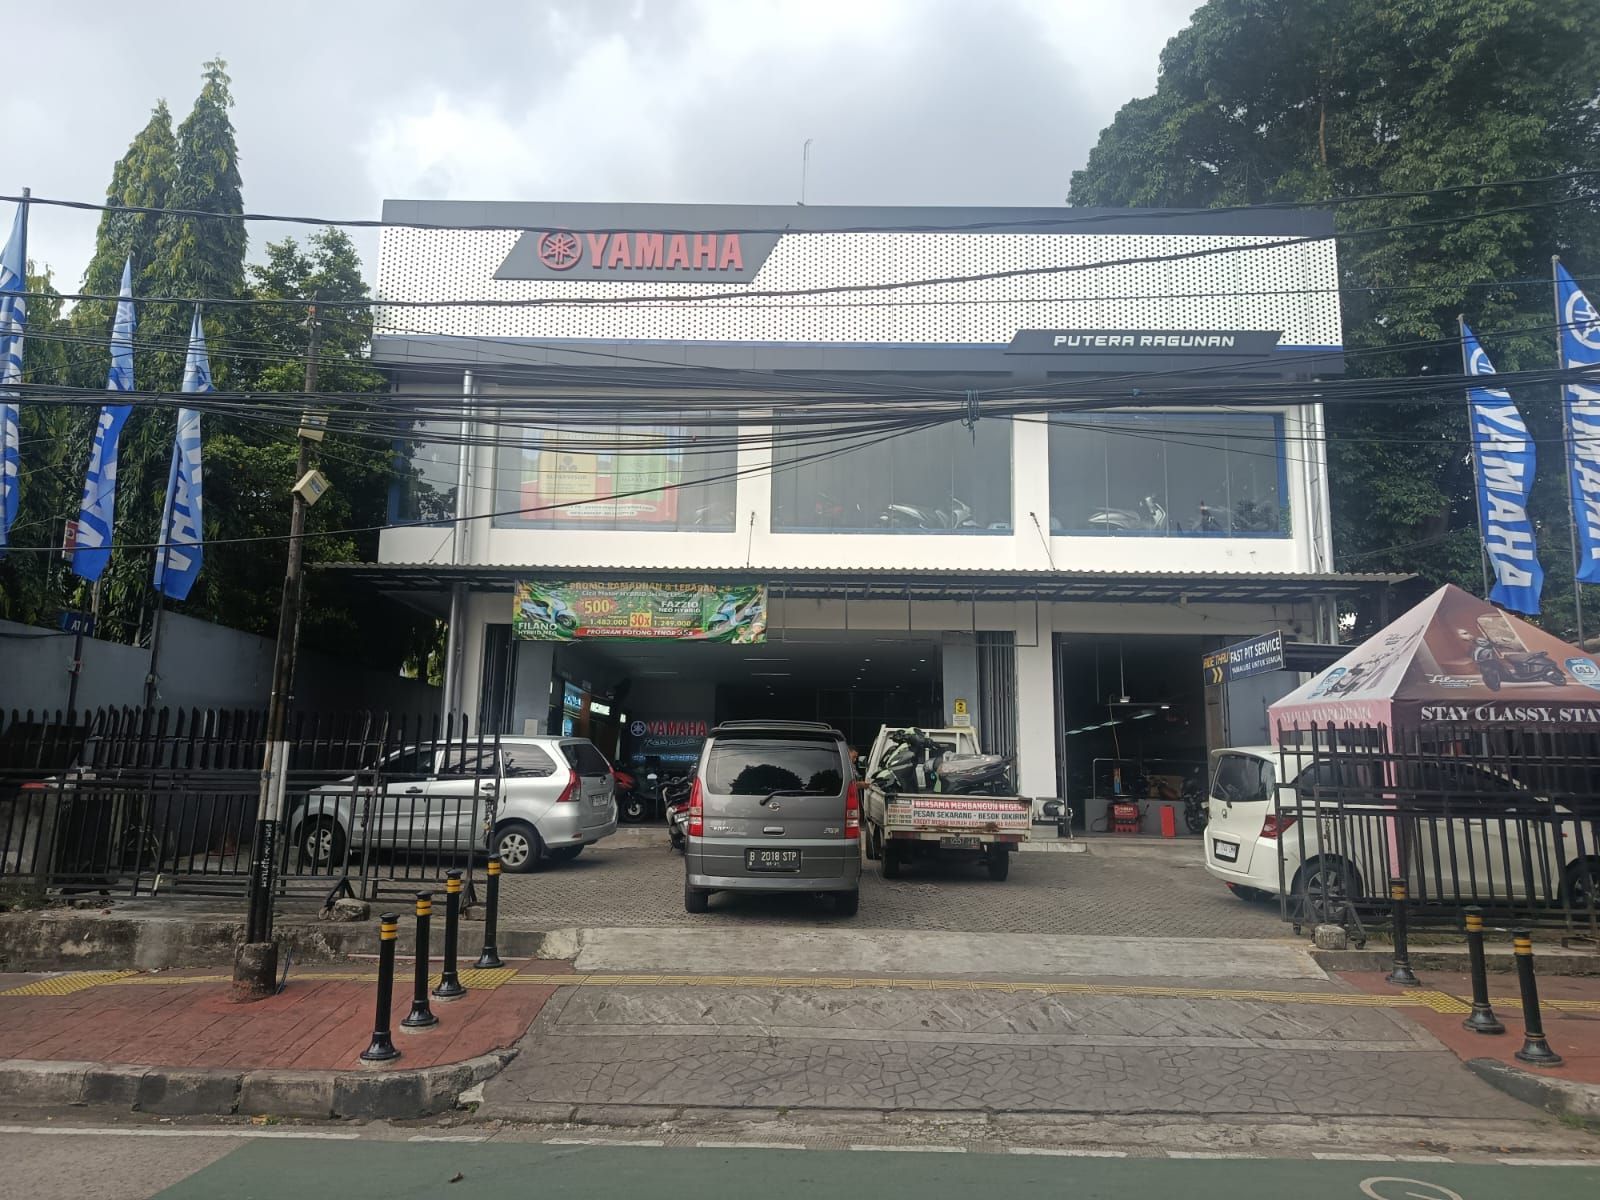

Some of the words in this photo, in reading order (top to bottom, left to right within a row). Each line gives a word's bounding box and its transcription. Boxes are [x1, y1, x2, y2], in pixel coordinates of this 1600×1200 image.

[586, 232, 744, 271] YAMAHA
[1053, 335, 1135, 347] PUTERA
[1139, 336, 1235, 347] RAGUNAN
[1474, 404, 1534, 589] YAMAHA
[583, 600, 611, 615] 500
[661, 600, 699, 608] FAZZIO
[518, 622, 558, 631] FILANO
[1230, 649, 1243, 664] FAST
[1244, 645, 1254, 660] PIT
[1254, 637, 1281, 657] SERVICE
[1421, 706, 1471, 721] STAY
[1474, 707, 1556, 724] CLASSY,
[648, 720, 707, 736] YAMAHA
[915, 801, 950, 810] BERSAMA
[951, 802, 998, 811] MEMBANGUN
[913, 810, 935, 818] PESAN
[936, 811, 972, 819] SEKARANG
[978, 812, 1000, 820] BESOK
[1001, 813, 1028, 821] DIKIRIM
[750, 851, 756, 861] B
[761, 851, 780, 861] 2018
[782, 851, 797, 861] STP
